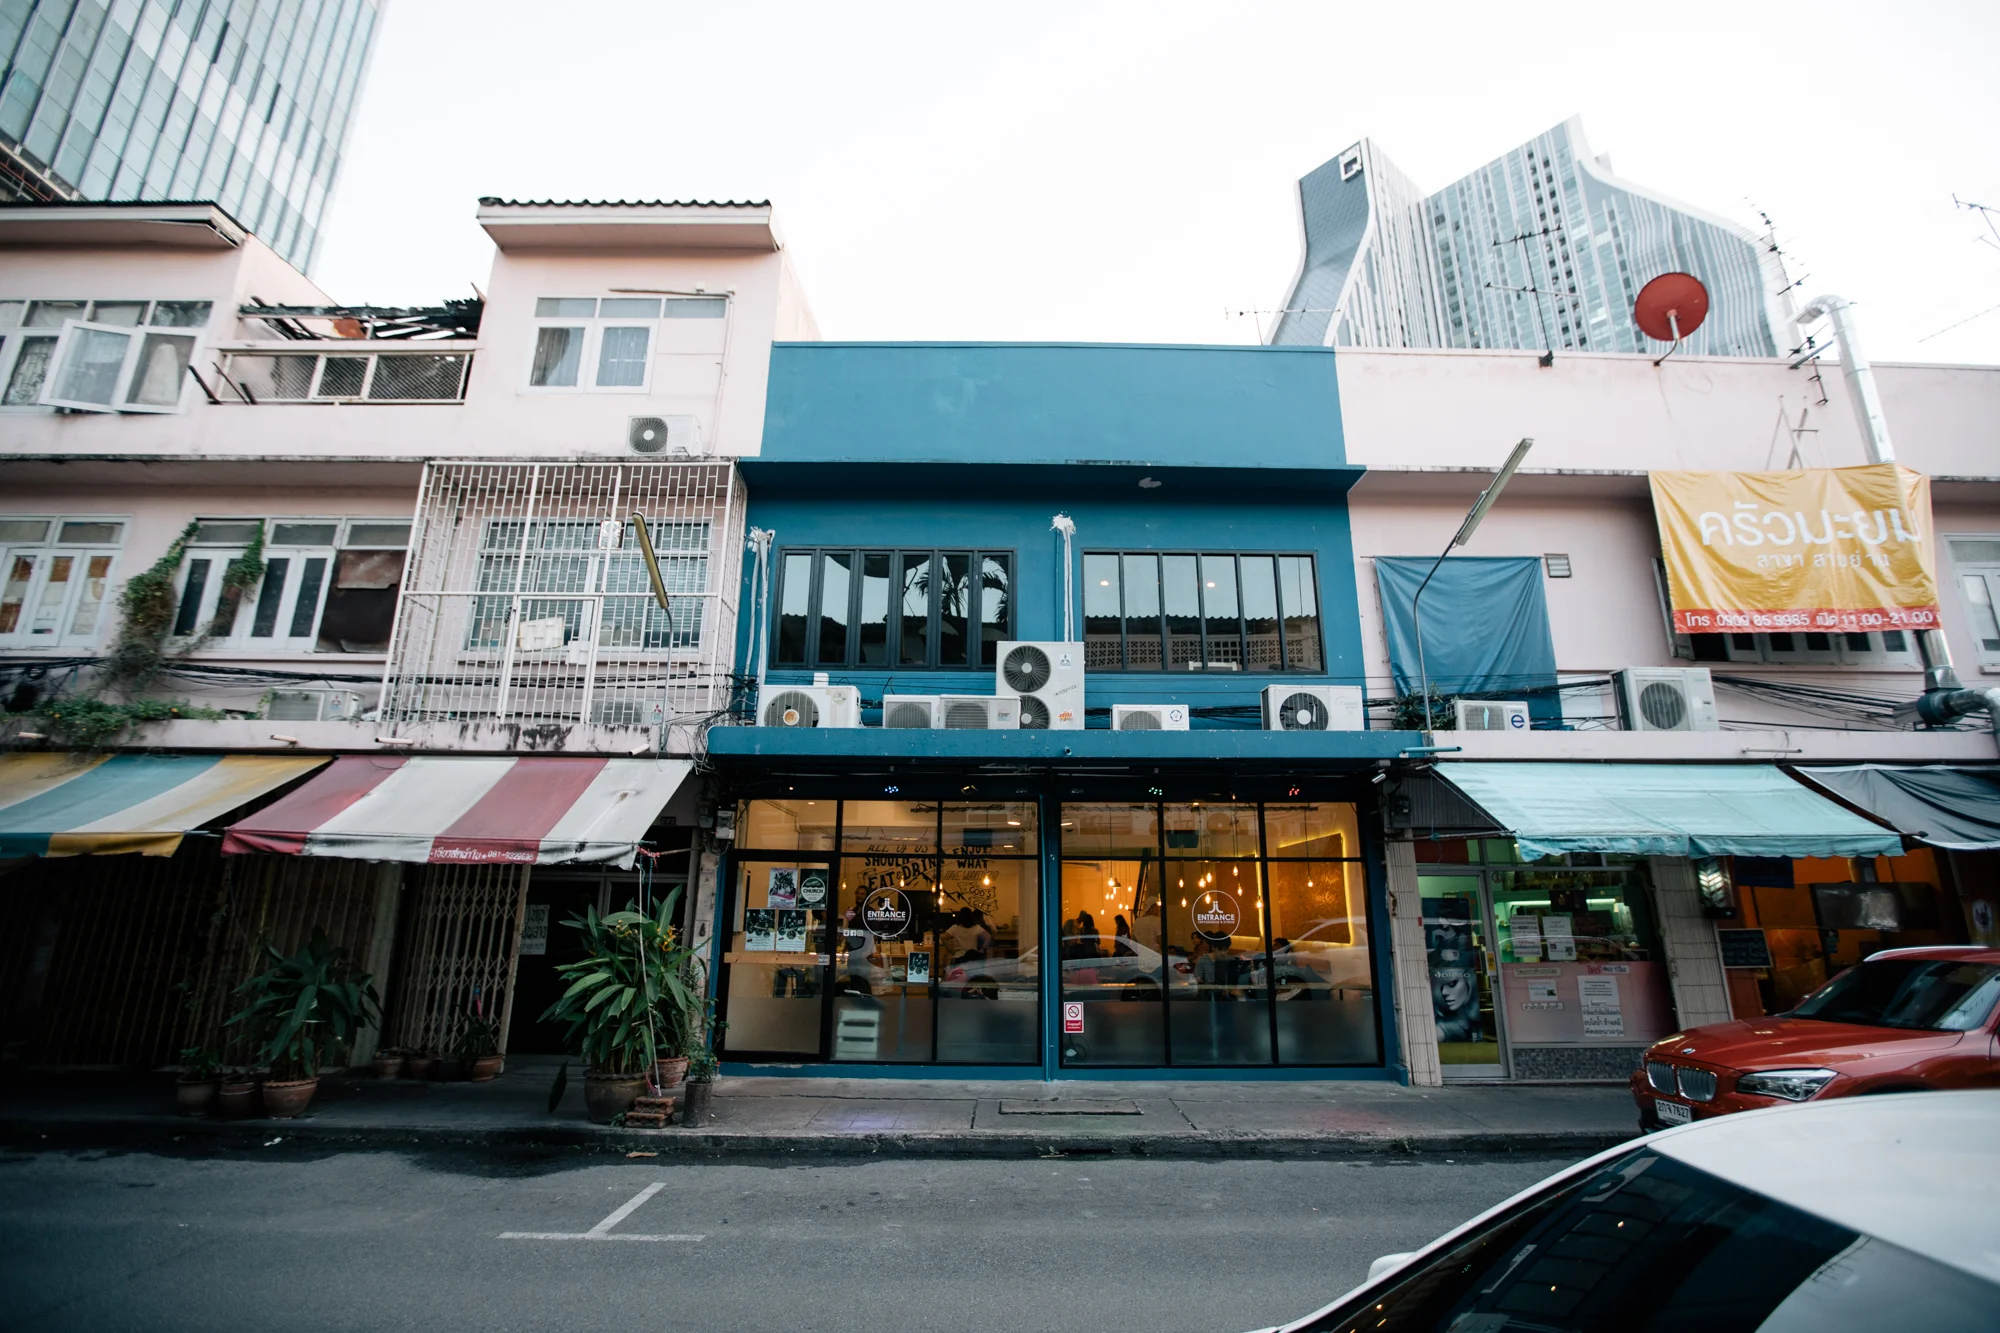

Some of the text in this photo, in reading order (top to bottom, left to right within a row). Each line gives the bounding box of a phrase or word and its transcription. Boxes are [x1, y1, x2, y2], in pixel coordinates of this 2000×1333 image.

[1756, 553, 1804, 568] สาขา
[1685, 612, 1710, 626] โทร
[1716, 614, 1750, 626] 0909
[1753, 614, 1771, 626] 85
[1774, 613, 1810, 626] 9985
[957, 858, 988, 868] WHAT
[868, 871, 895, 890] EAT
[902, 857, 944, 880] DRIN
[1672, 1104, 1689, 1119] 7627
